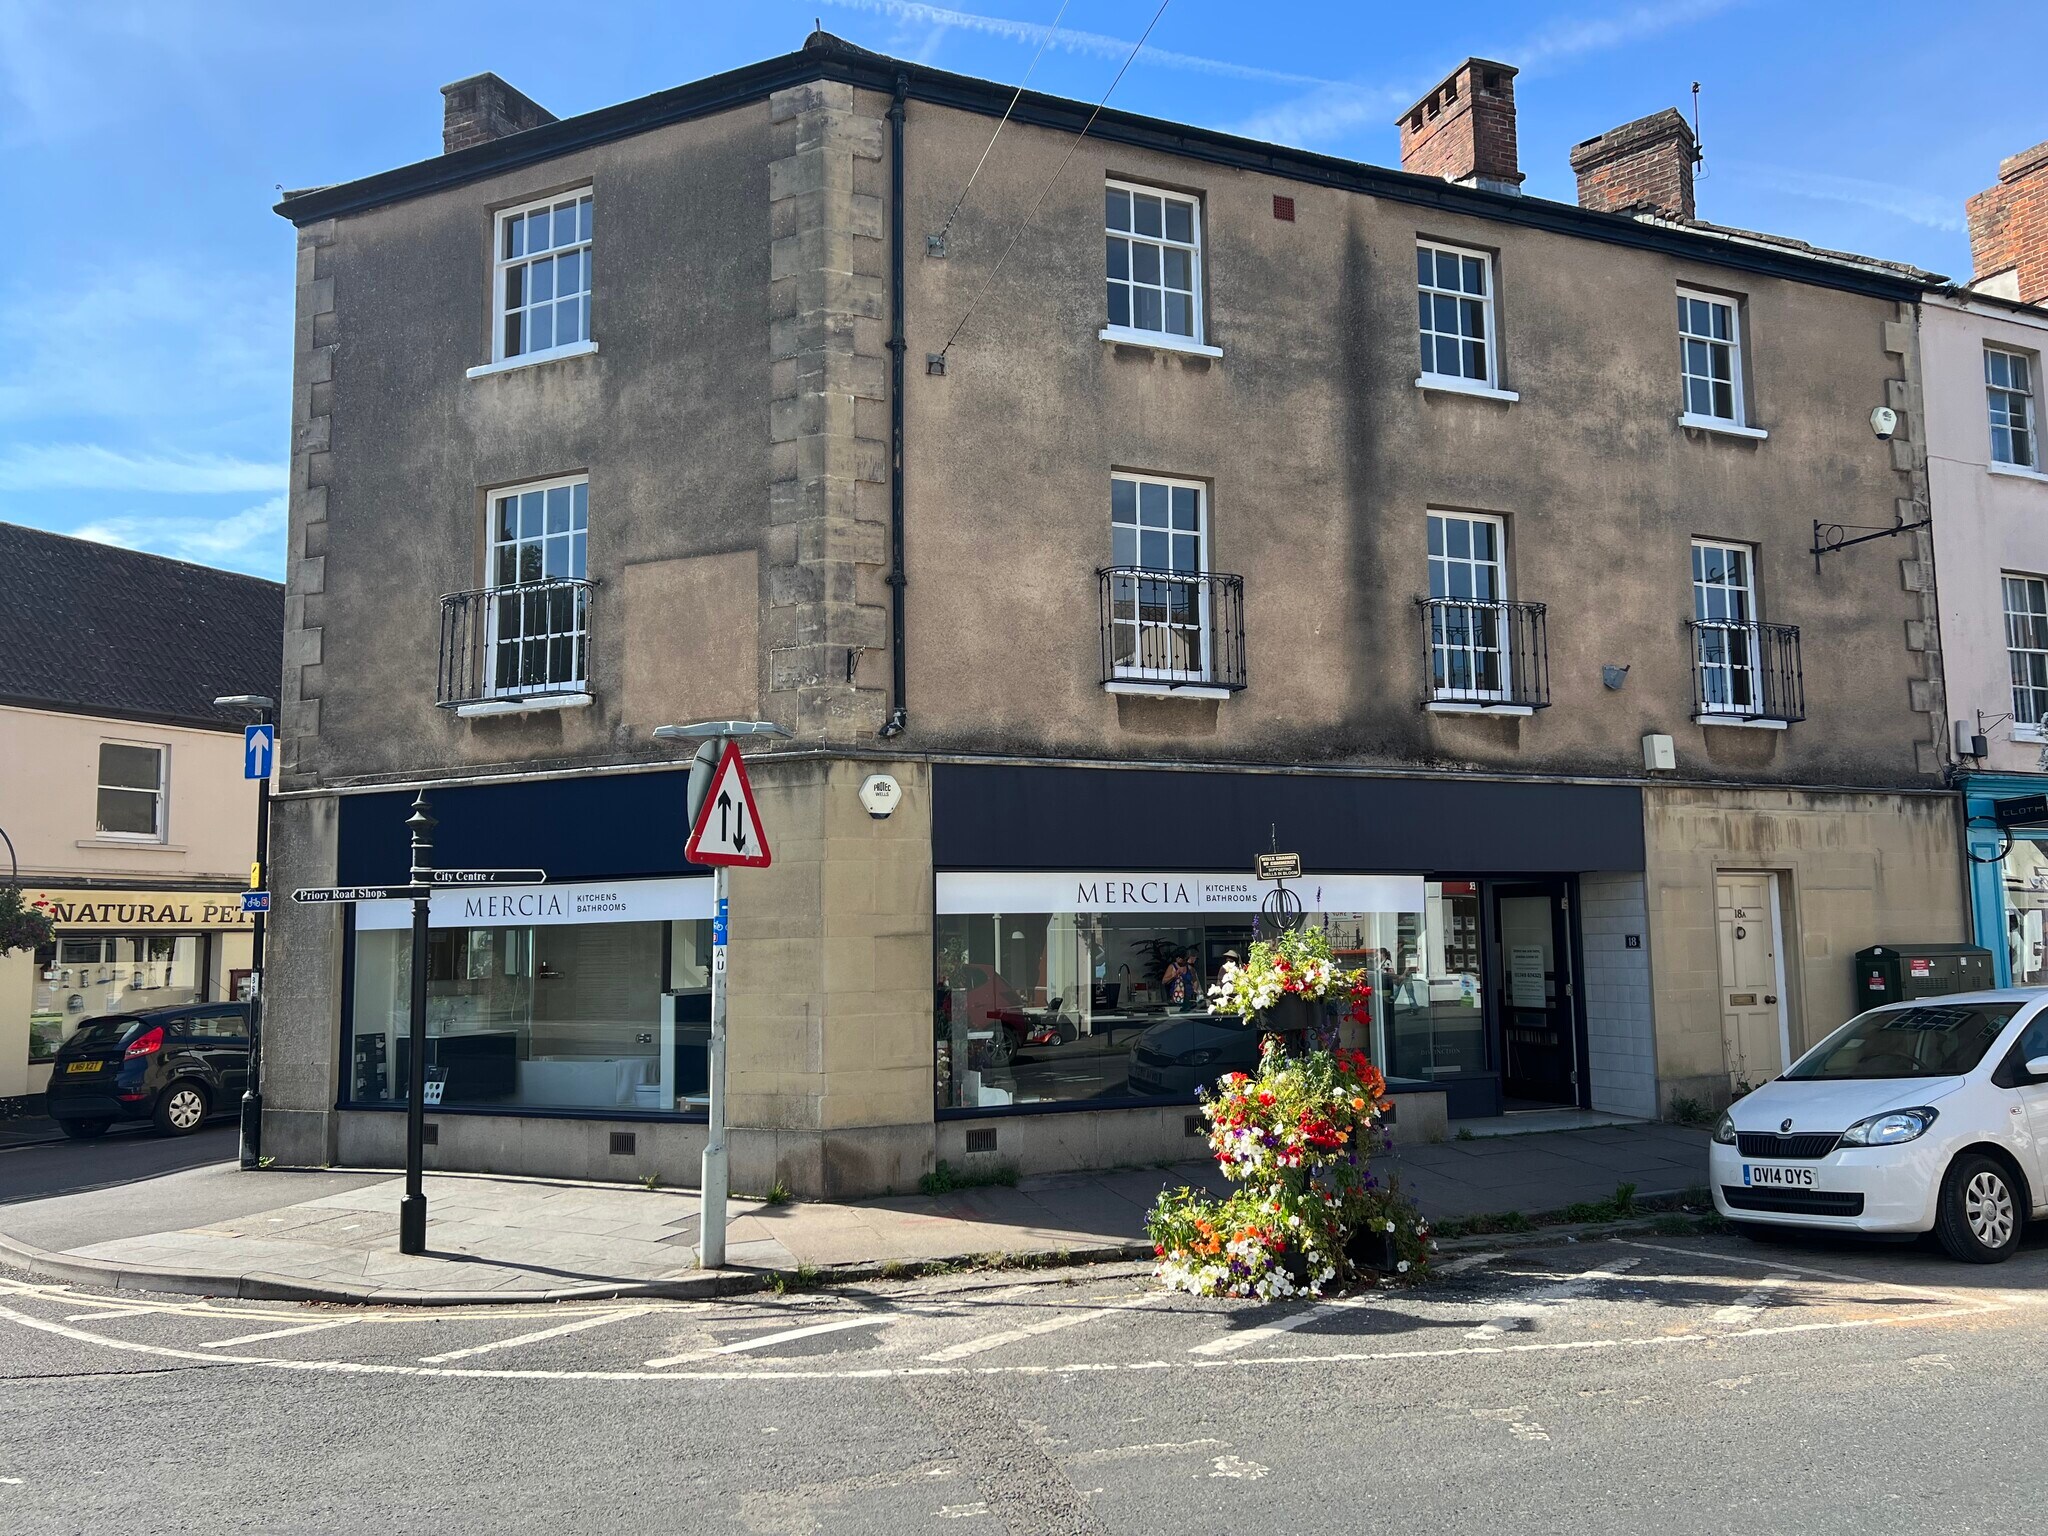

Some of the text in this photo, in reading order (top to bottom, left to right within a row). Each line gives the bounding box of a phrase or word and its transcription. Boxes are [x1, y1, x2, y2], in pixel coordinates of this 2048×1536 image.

[434, 871, 454, 882] City
[456, 871, 487, 881] Centre
[1077, 881, 1190, 904] MERCIA
[1205, 884, 1248, 892] KITCHENS
[300, 887, 387, 901] Priory Road Shops
[577, 893, 617, 902] KITCHENS
[1206, 894, 1258, 902] BATHROOMS
[464, 894, 562, 918] MERCIA
[576, 903, 627, 913] BATHROOMS
[54, 903, 255, 923] NATURAL PET
[1628, 936, 1637, 946] 18
[1753, 1167, 1813, 1185] OV14 OYS
